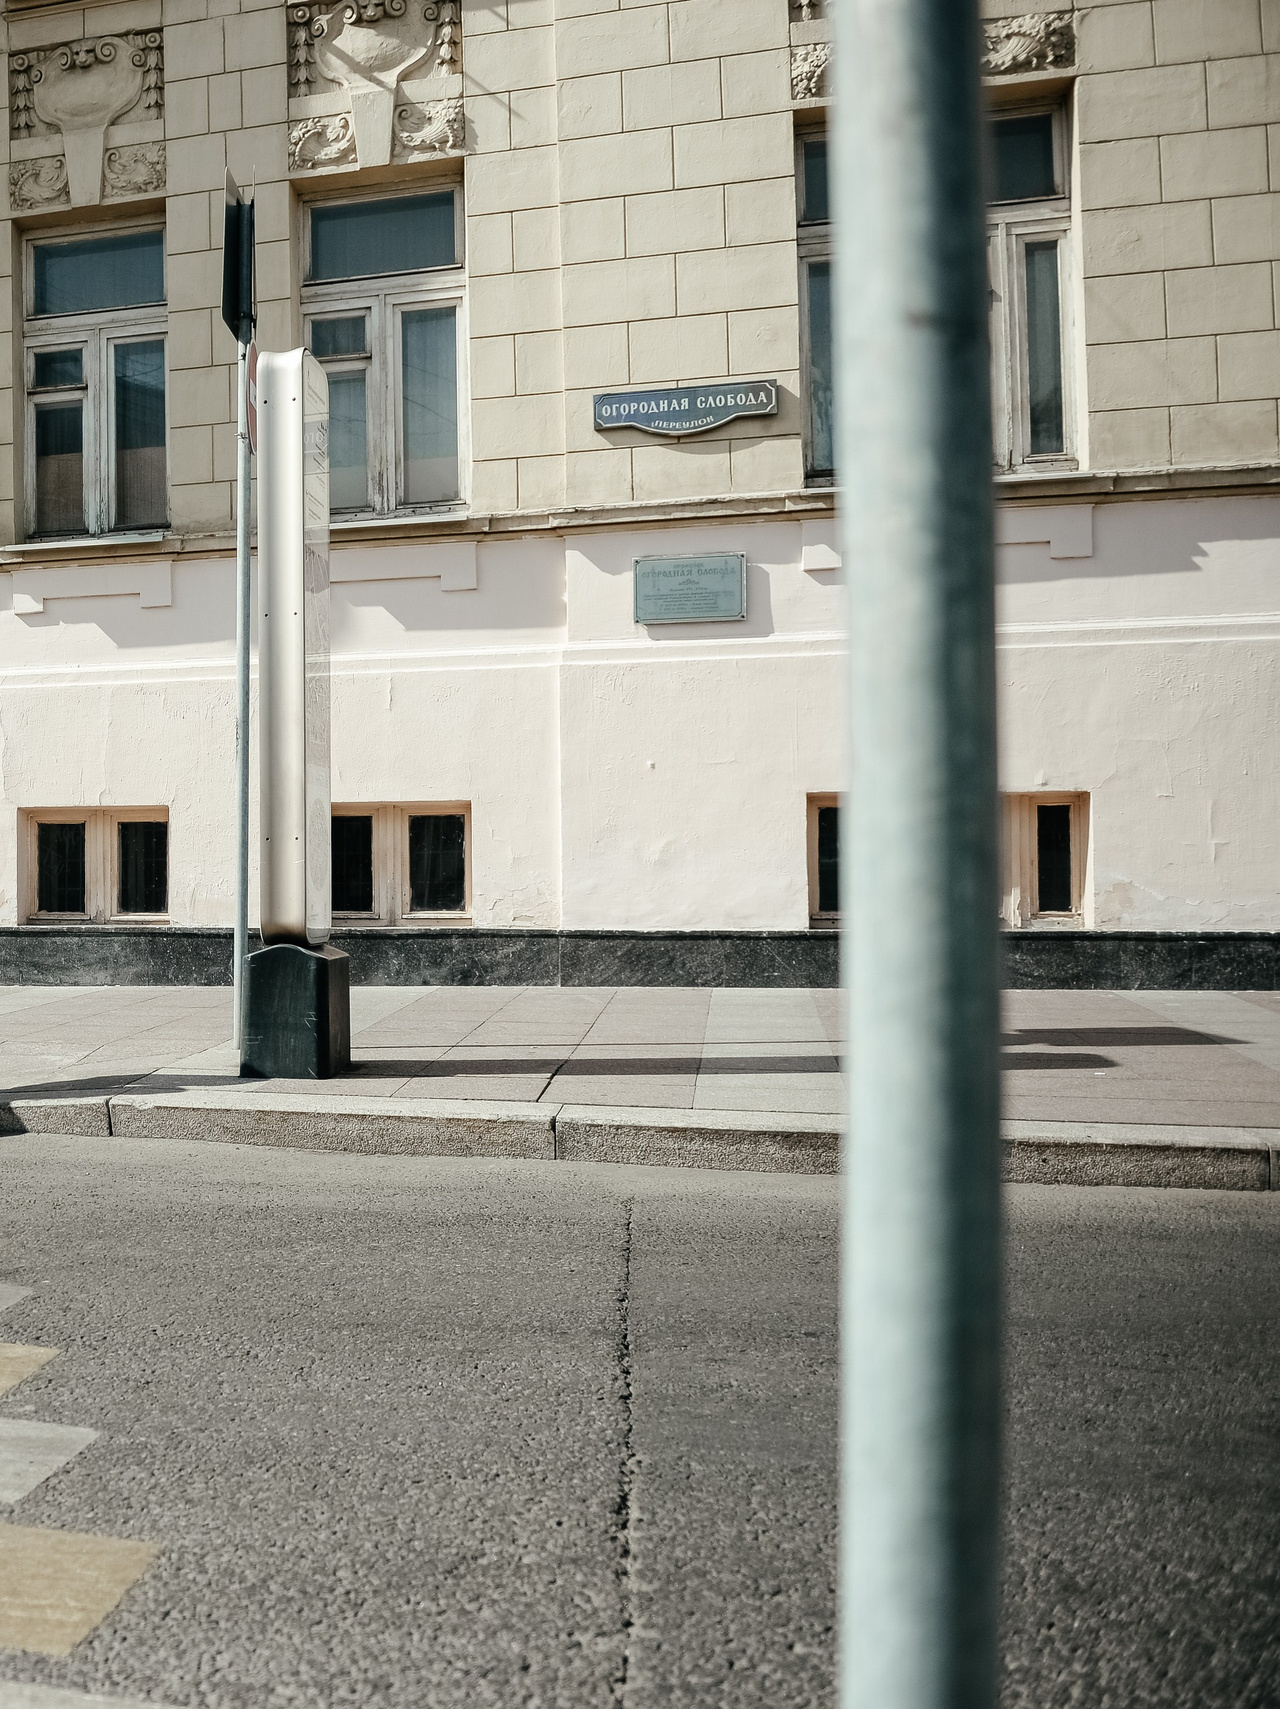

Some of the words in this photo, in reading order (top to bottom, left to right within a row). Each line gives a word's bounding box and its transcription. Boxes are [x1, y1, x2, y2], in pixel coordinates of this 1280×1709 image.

[602, 397, 689, 417] ОГОРОДНАЯ
[697, 391, 768, 408] СЛОБОДА
[654, 415, 715, 429] ПЕРЕУЛОК
[641, 569, 693, 579] ОГОРОДНАЯ
[697, 567, 737, 577] СЛОБОДА
